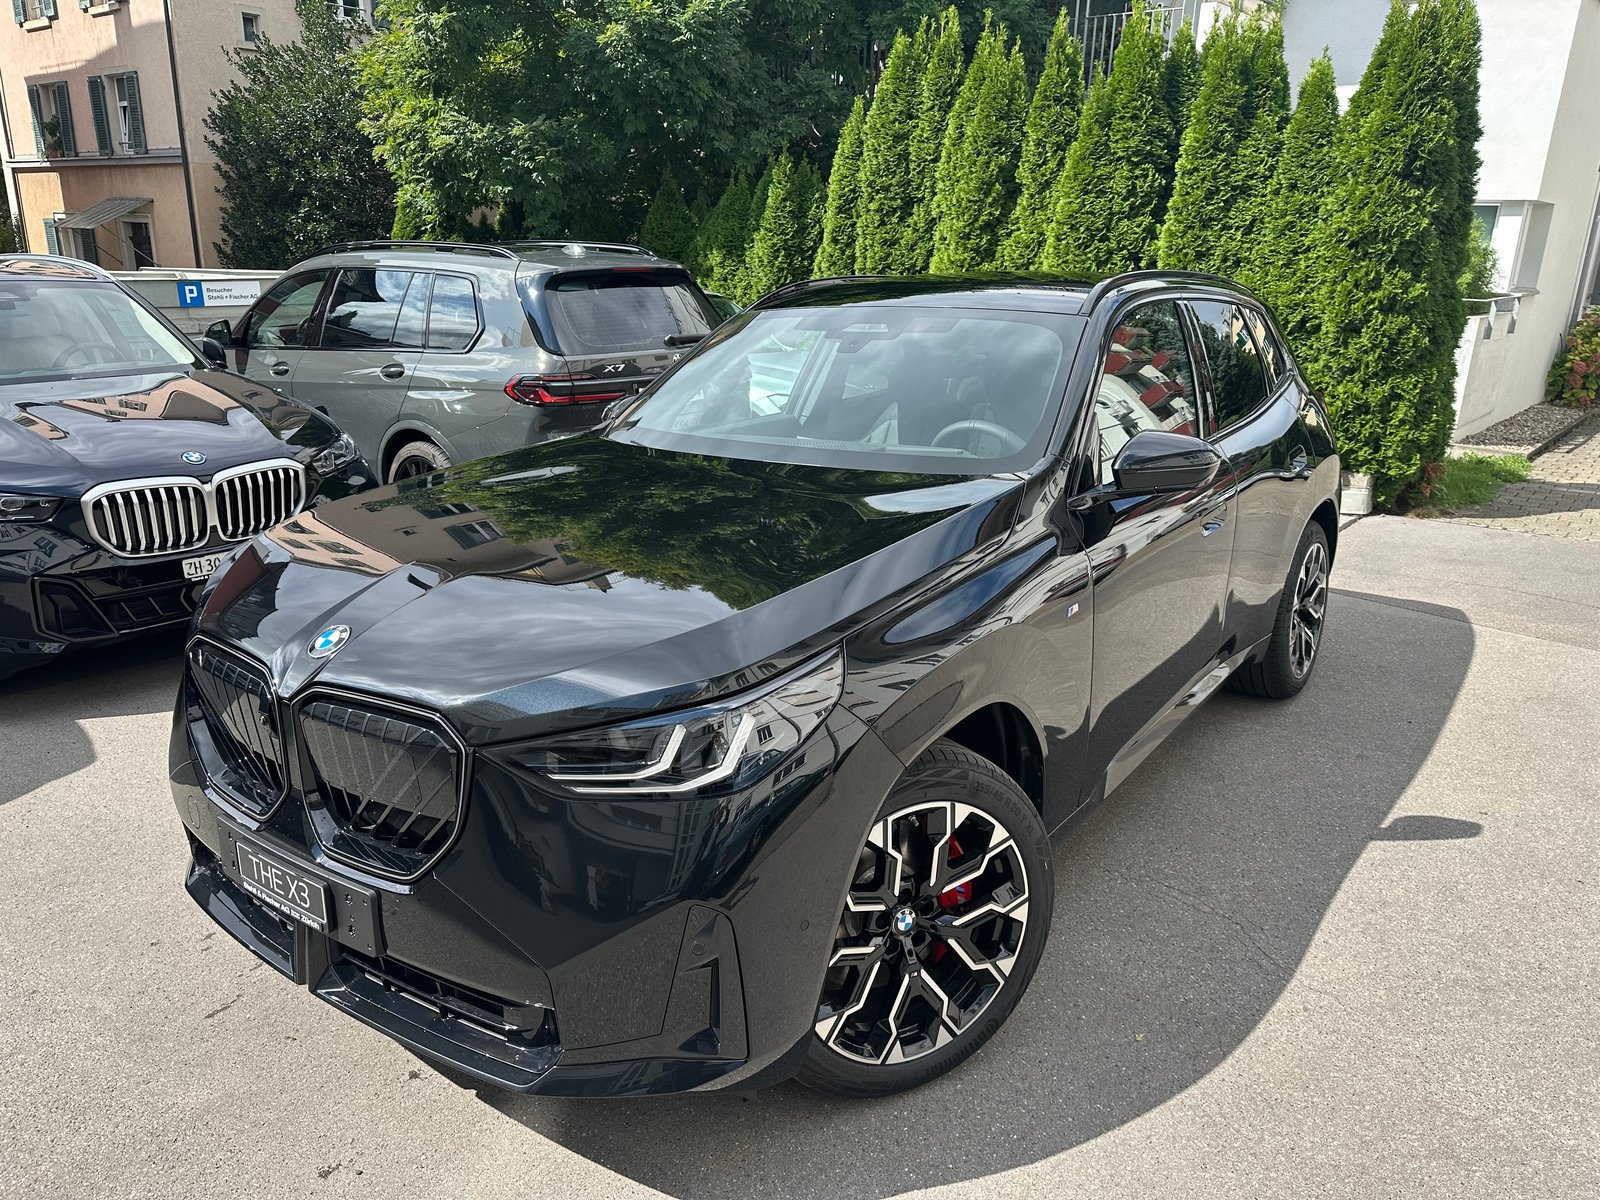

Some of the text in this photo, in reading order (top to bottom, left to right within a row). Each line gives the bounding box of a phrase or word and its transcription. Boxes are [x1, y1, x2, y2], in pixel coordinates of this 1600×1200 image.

[184, 285, 198, 304] P
[602, 364, 626, 373] X7
[248, 854, 310, 908] THE X3
